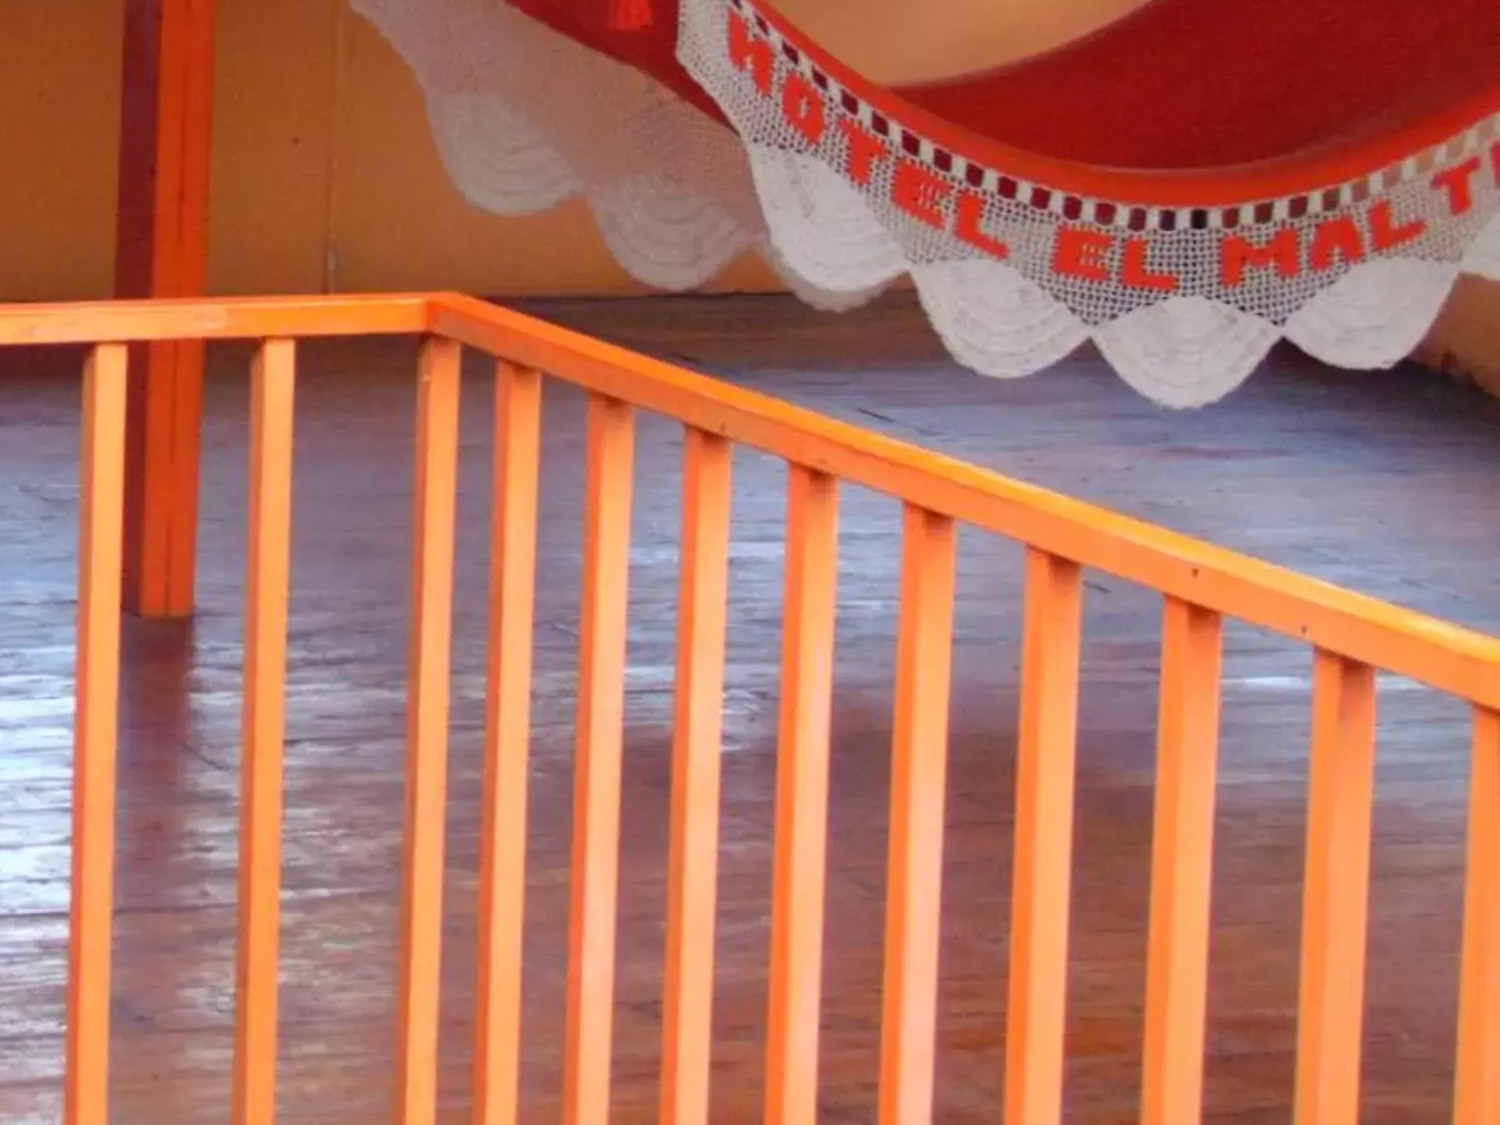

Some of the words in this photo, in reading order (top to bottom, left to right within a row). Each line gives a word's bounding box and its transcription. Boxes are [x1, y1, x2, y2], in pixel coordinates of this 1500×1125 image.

[726, 8, 1011, 261] HOTEL
[1050, 223, 1181, 292] EL
[1219, 140, 1500, 289] MALT
